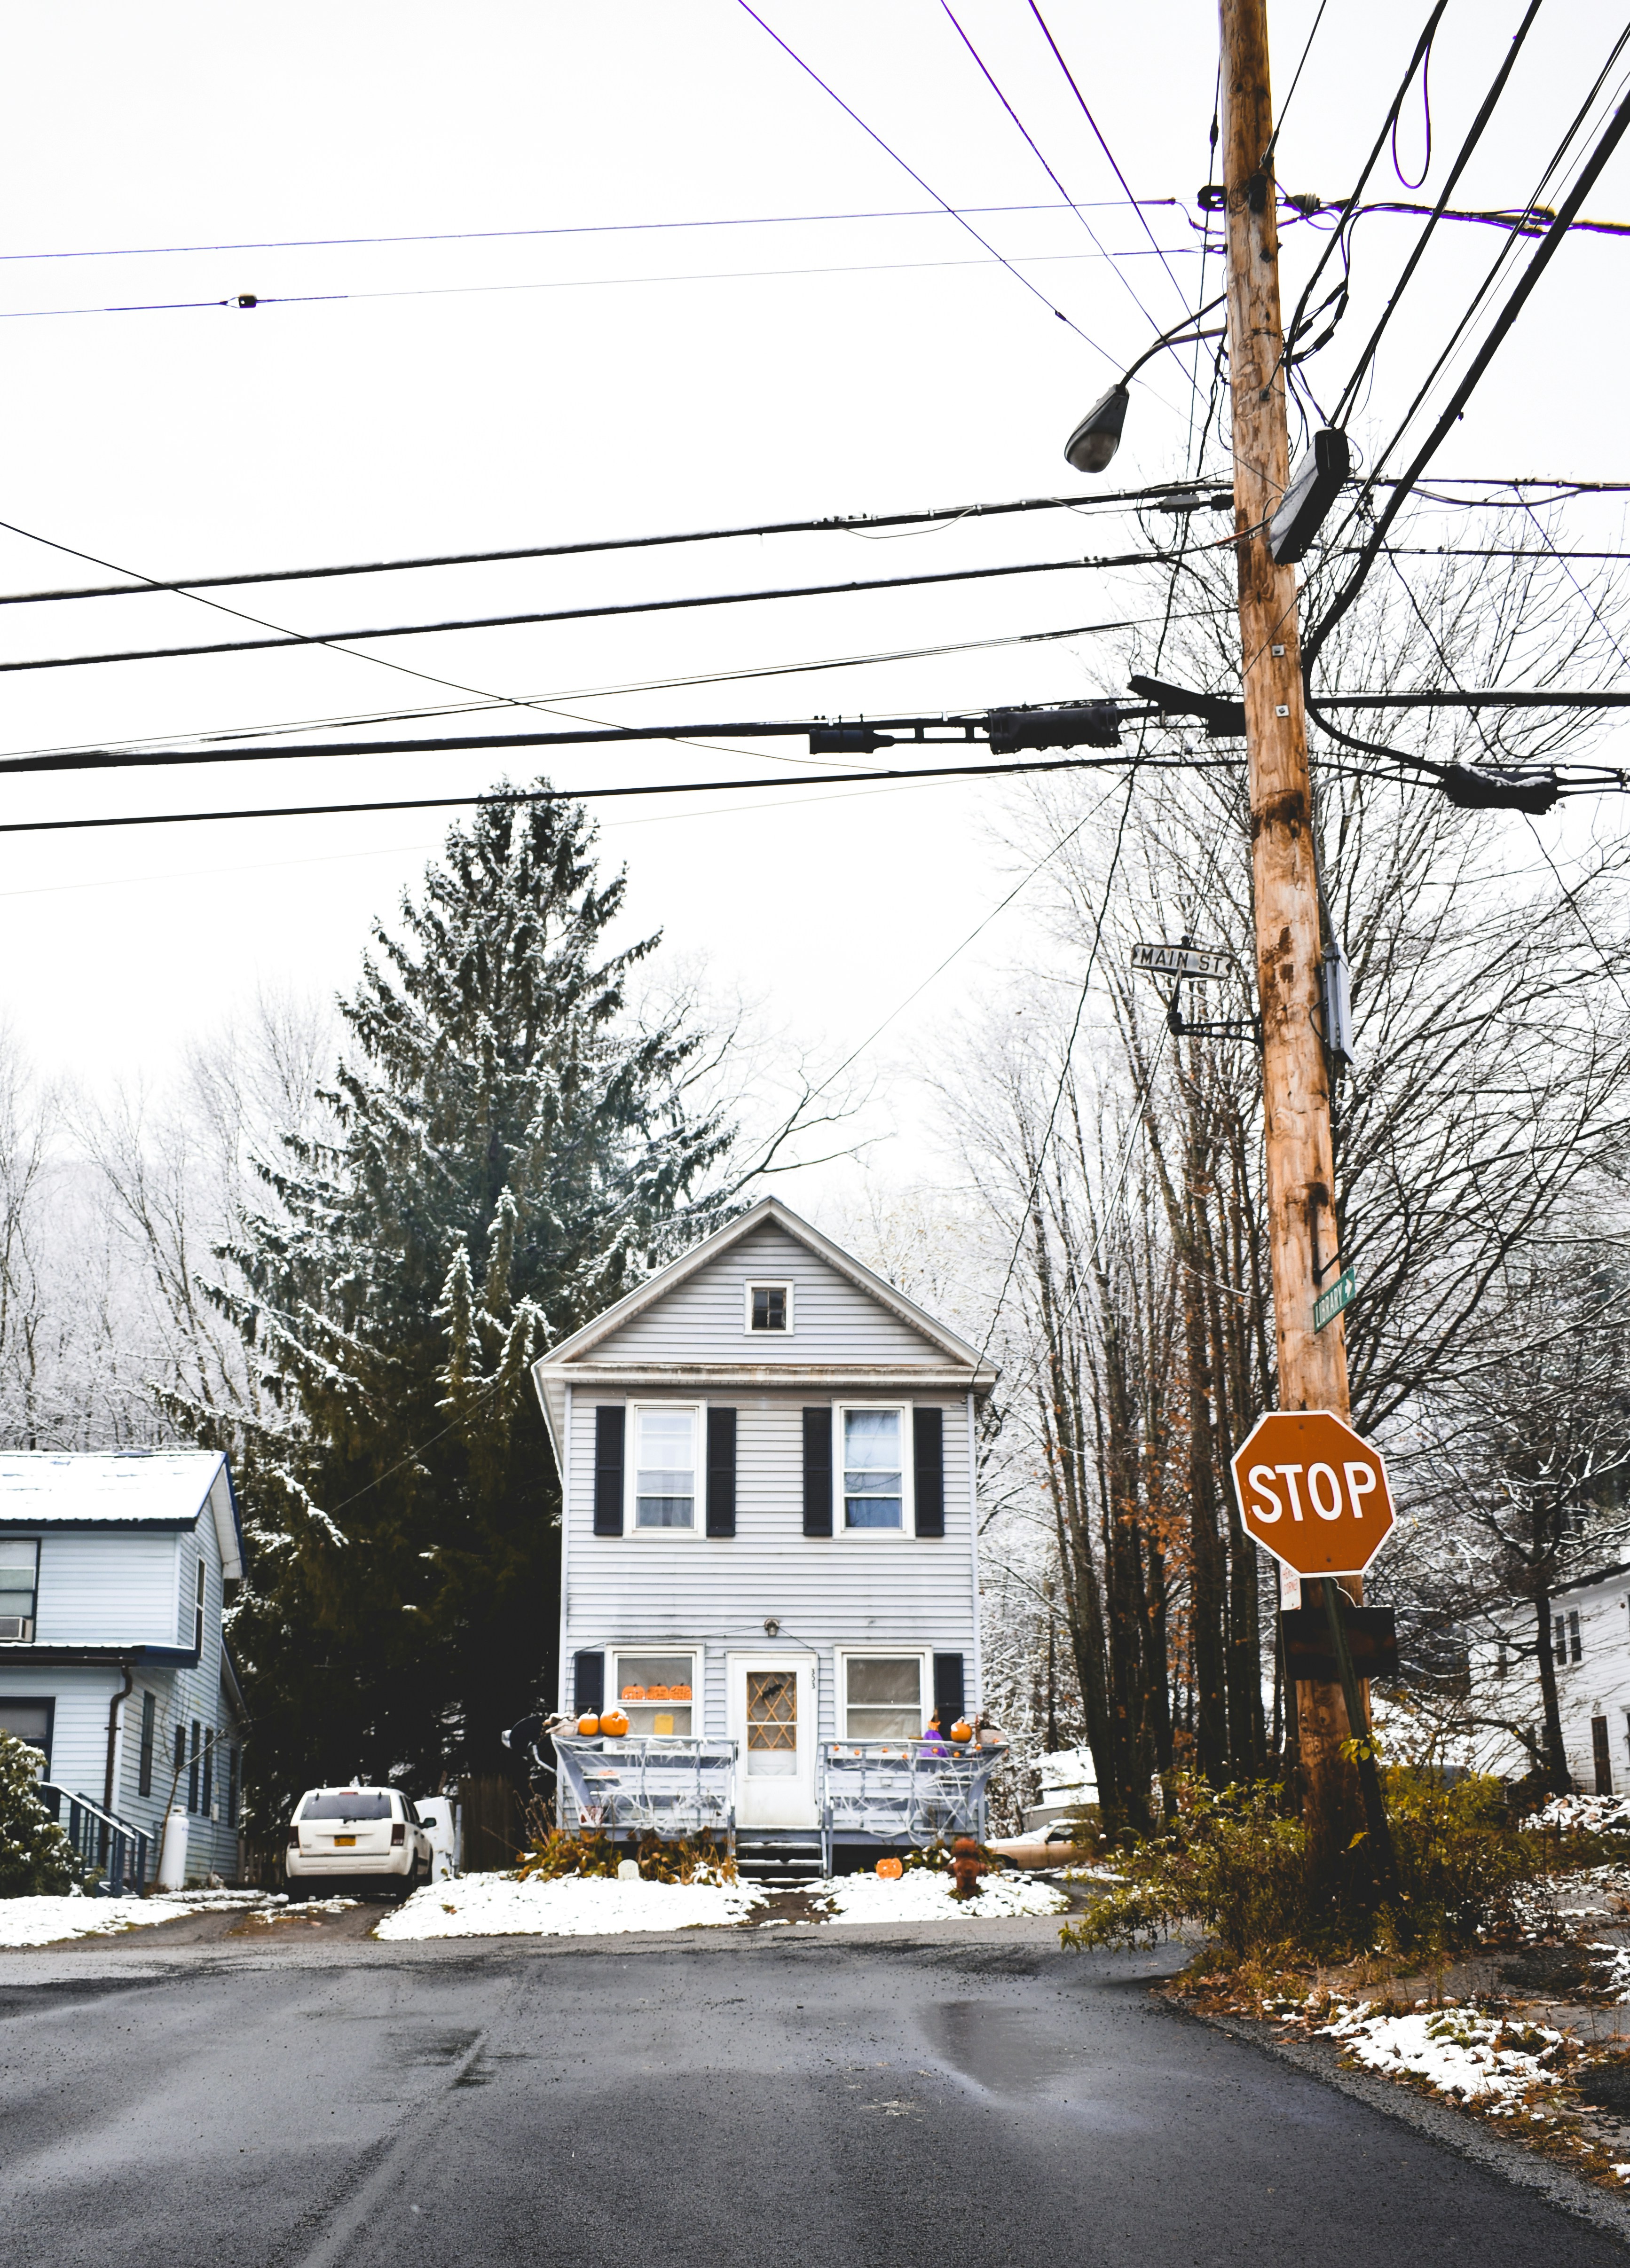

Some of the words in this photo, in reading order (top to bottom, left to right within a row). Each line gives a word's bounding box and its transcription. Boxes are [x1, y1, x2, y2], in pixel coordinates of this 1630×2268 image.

[1140, 948, 1189, 968] MAIN
[1315, 1282, 1343, 1327] LIBRARY
[1248, 1461, 1377, 1523] STOP
